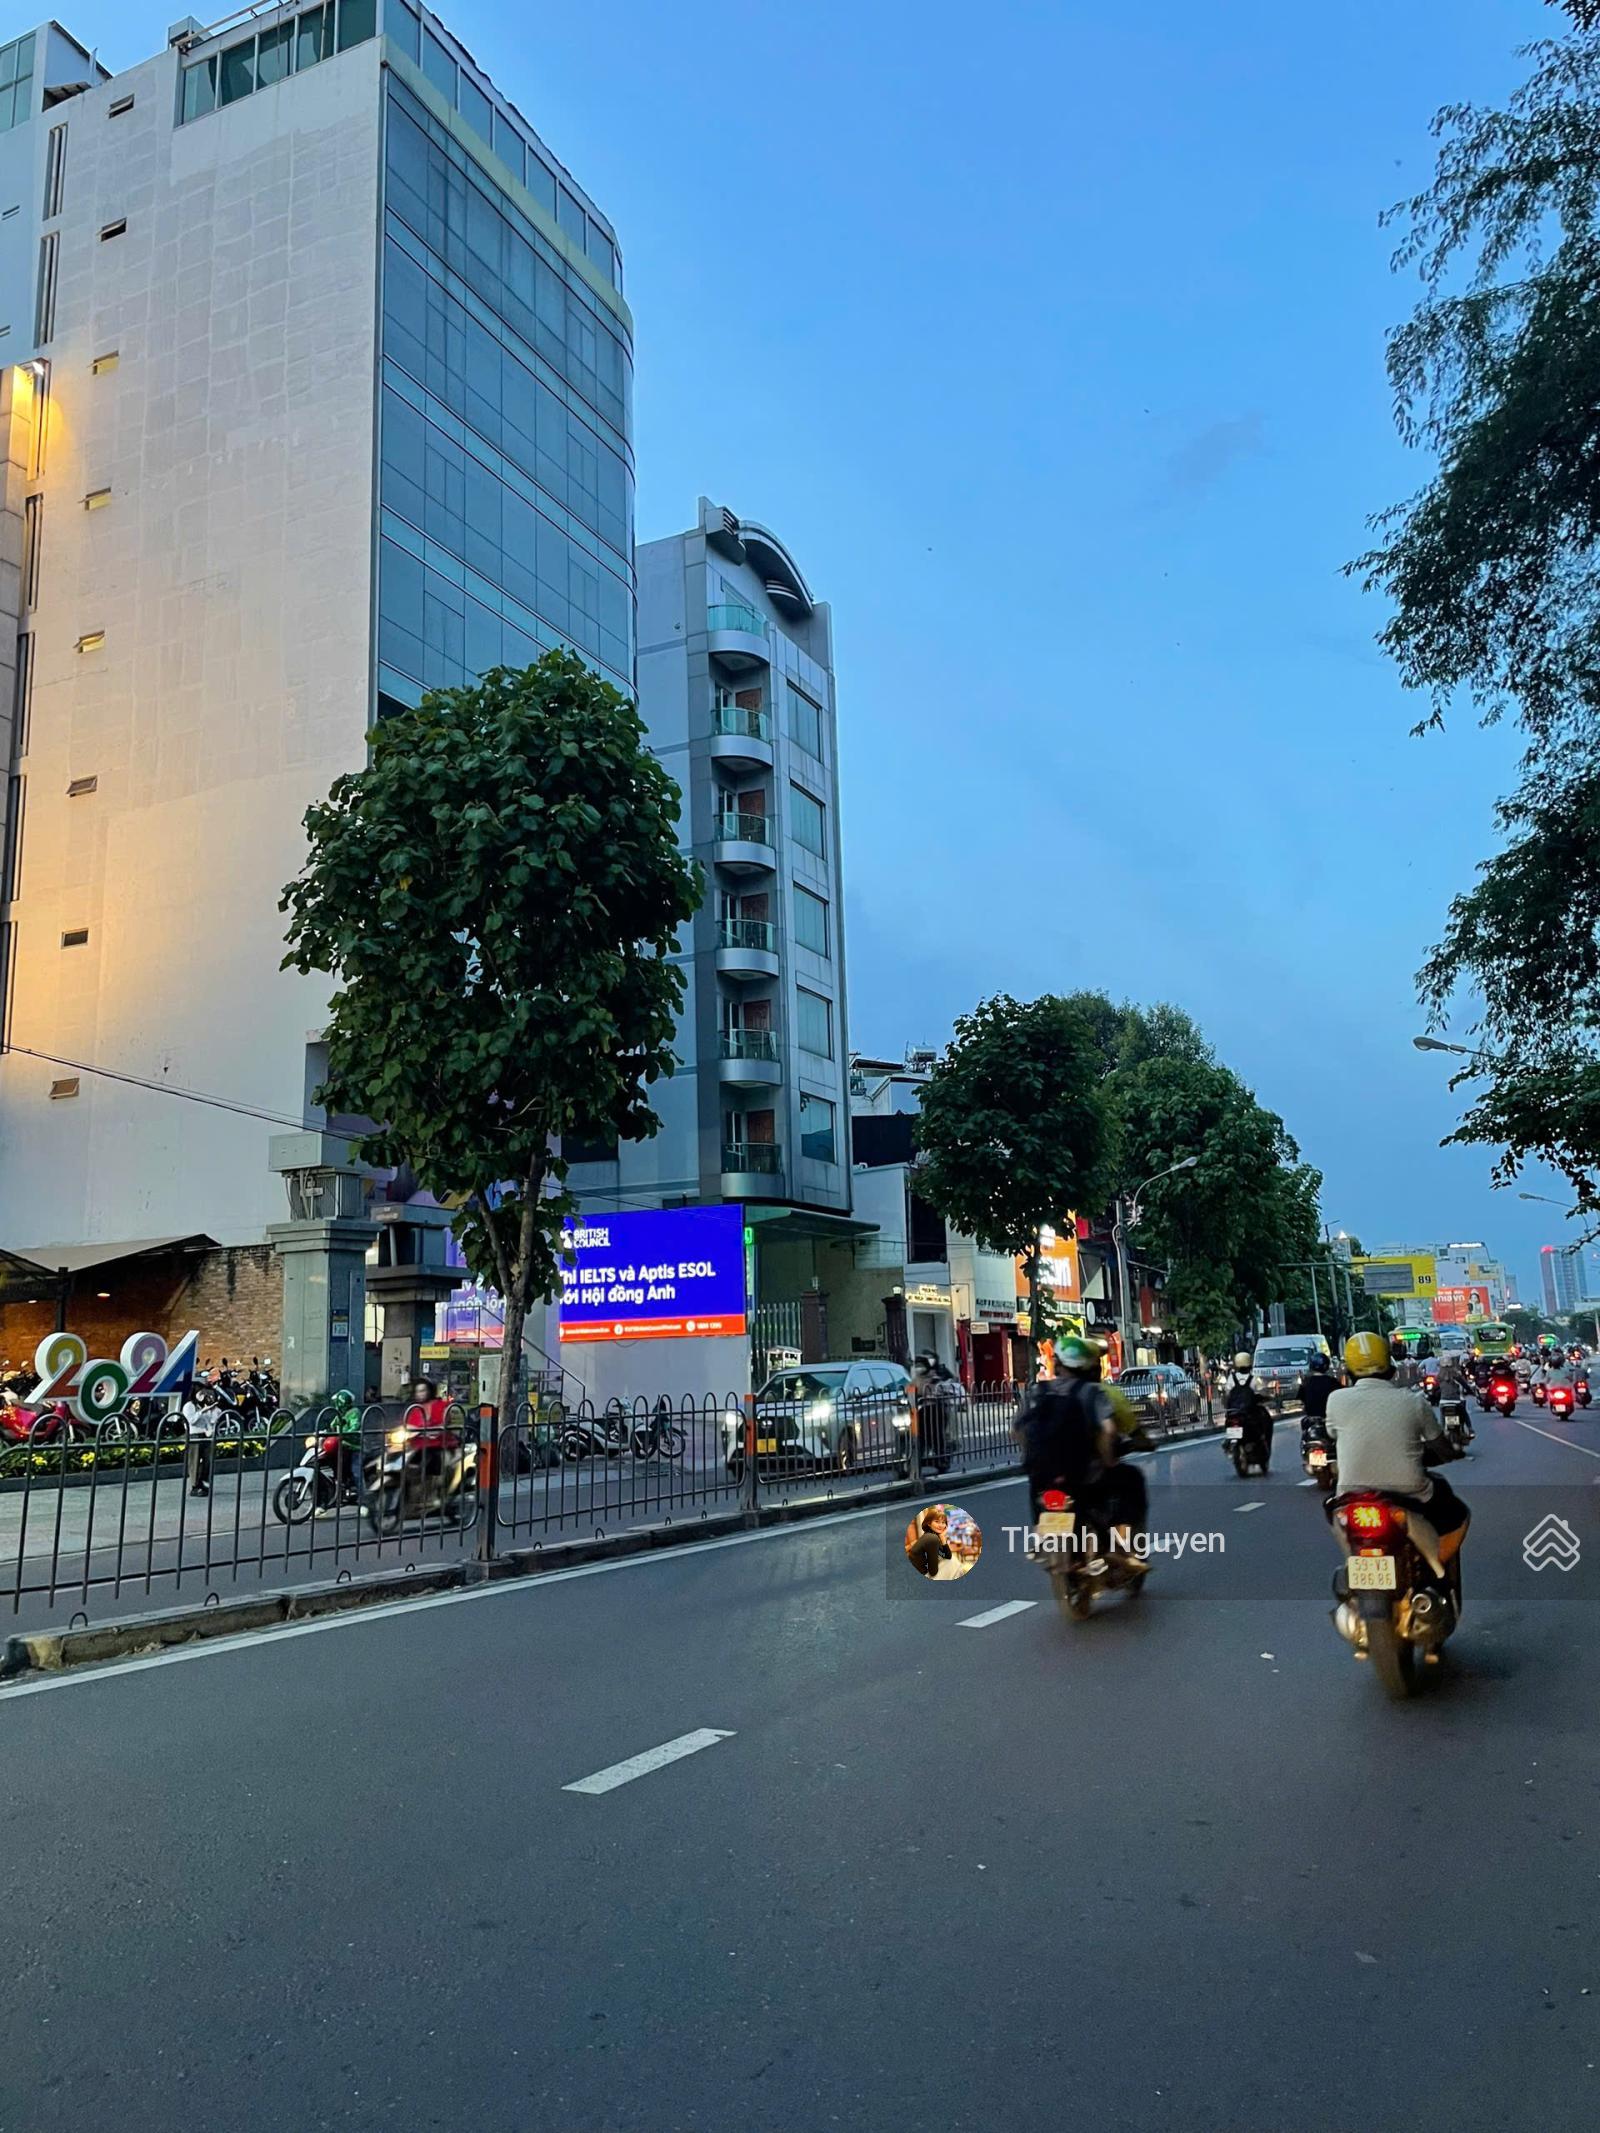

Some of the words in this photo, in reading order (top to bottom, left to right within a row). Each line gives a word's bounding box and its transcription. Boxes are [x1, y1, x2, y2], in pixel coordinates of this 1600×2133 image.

[573, 1227, 609, 1239] BRITISH
[573, 1237, 611, 1248] COUNCIL
[580, 1267, 616, 1284] IELTS
[618, 1265, 636, 1282] và
[638, 1264, 675, 1284] Aptis
[678, 1261, 716, 1278] ESOL
[1417, 1275, 1432, 1284] 89
[581, 1287, 605, 1307] Hội
[607, 1284, 644, 1304] đồng
[646, 1284, 676, 1300] Anh
[24, 1329, 203, 1425] 2024
